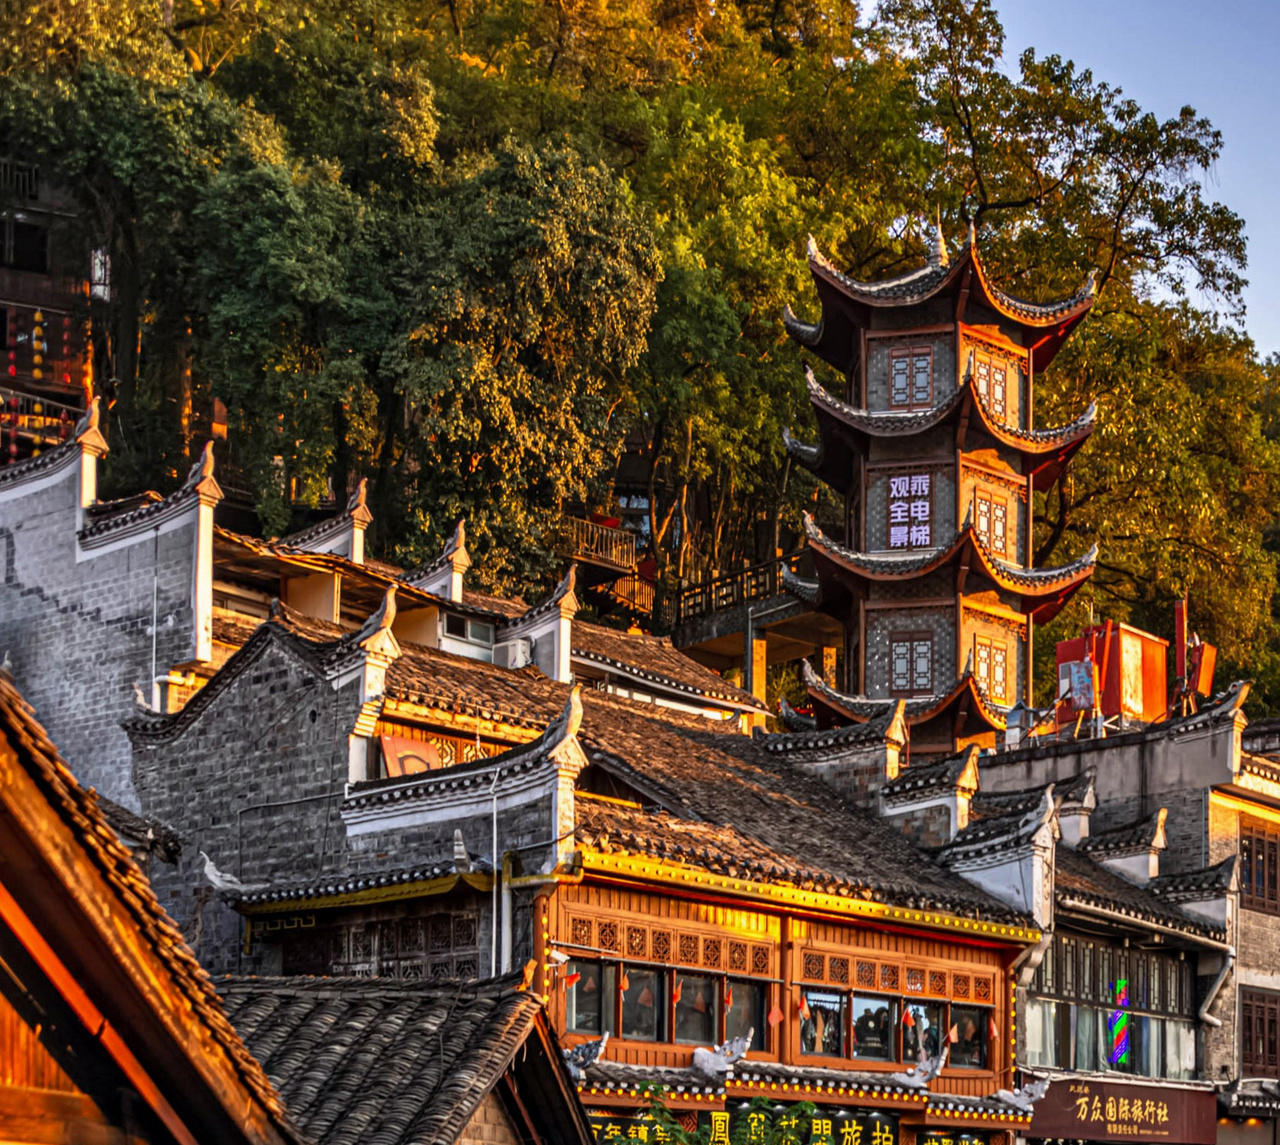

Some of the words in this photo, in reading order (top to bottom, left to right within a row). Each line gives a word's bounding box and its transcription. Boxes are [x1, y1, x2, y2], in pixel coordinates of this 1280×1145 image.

[890, 476, 909, 547] 观全景
[910, 474, 930, 546] 乘电梯
[1076, 1096, 1169, 1125] 万众国际旅行社
